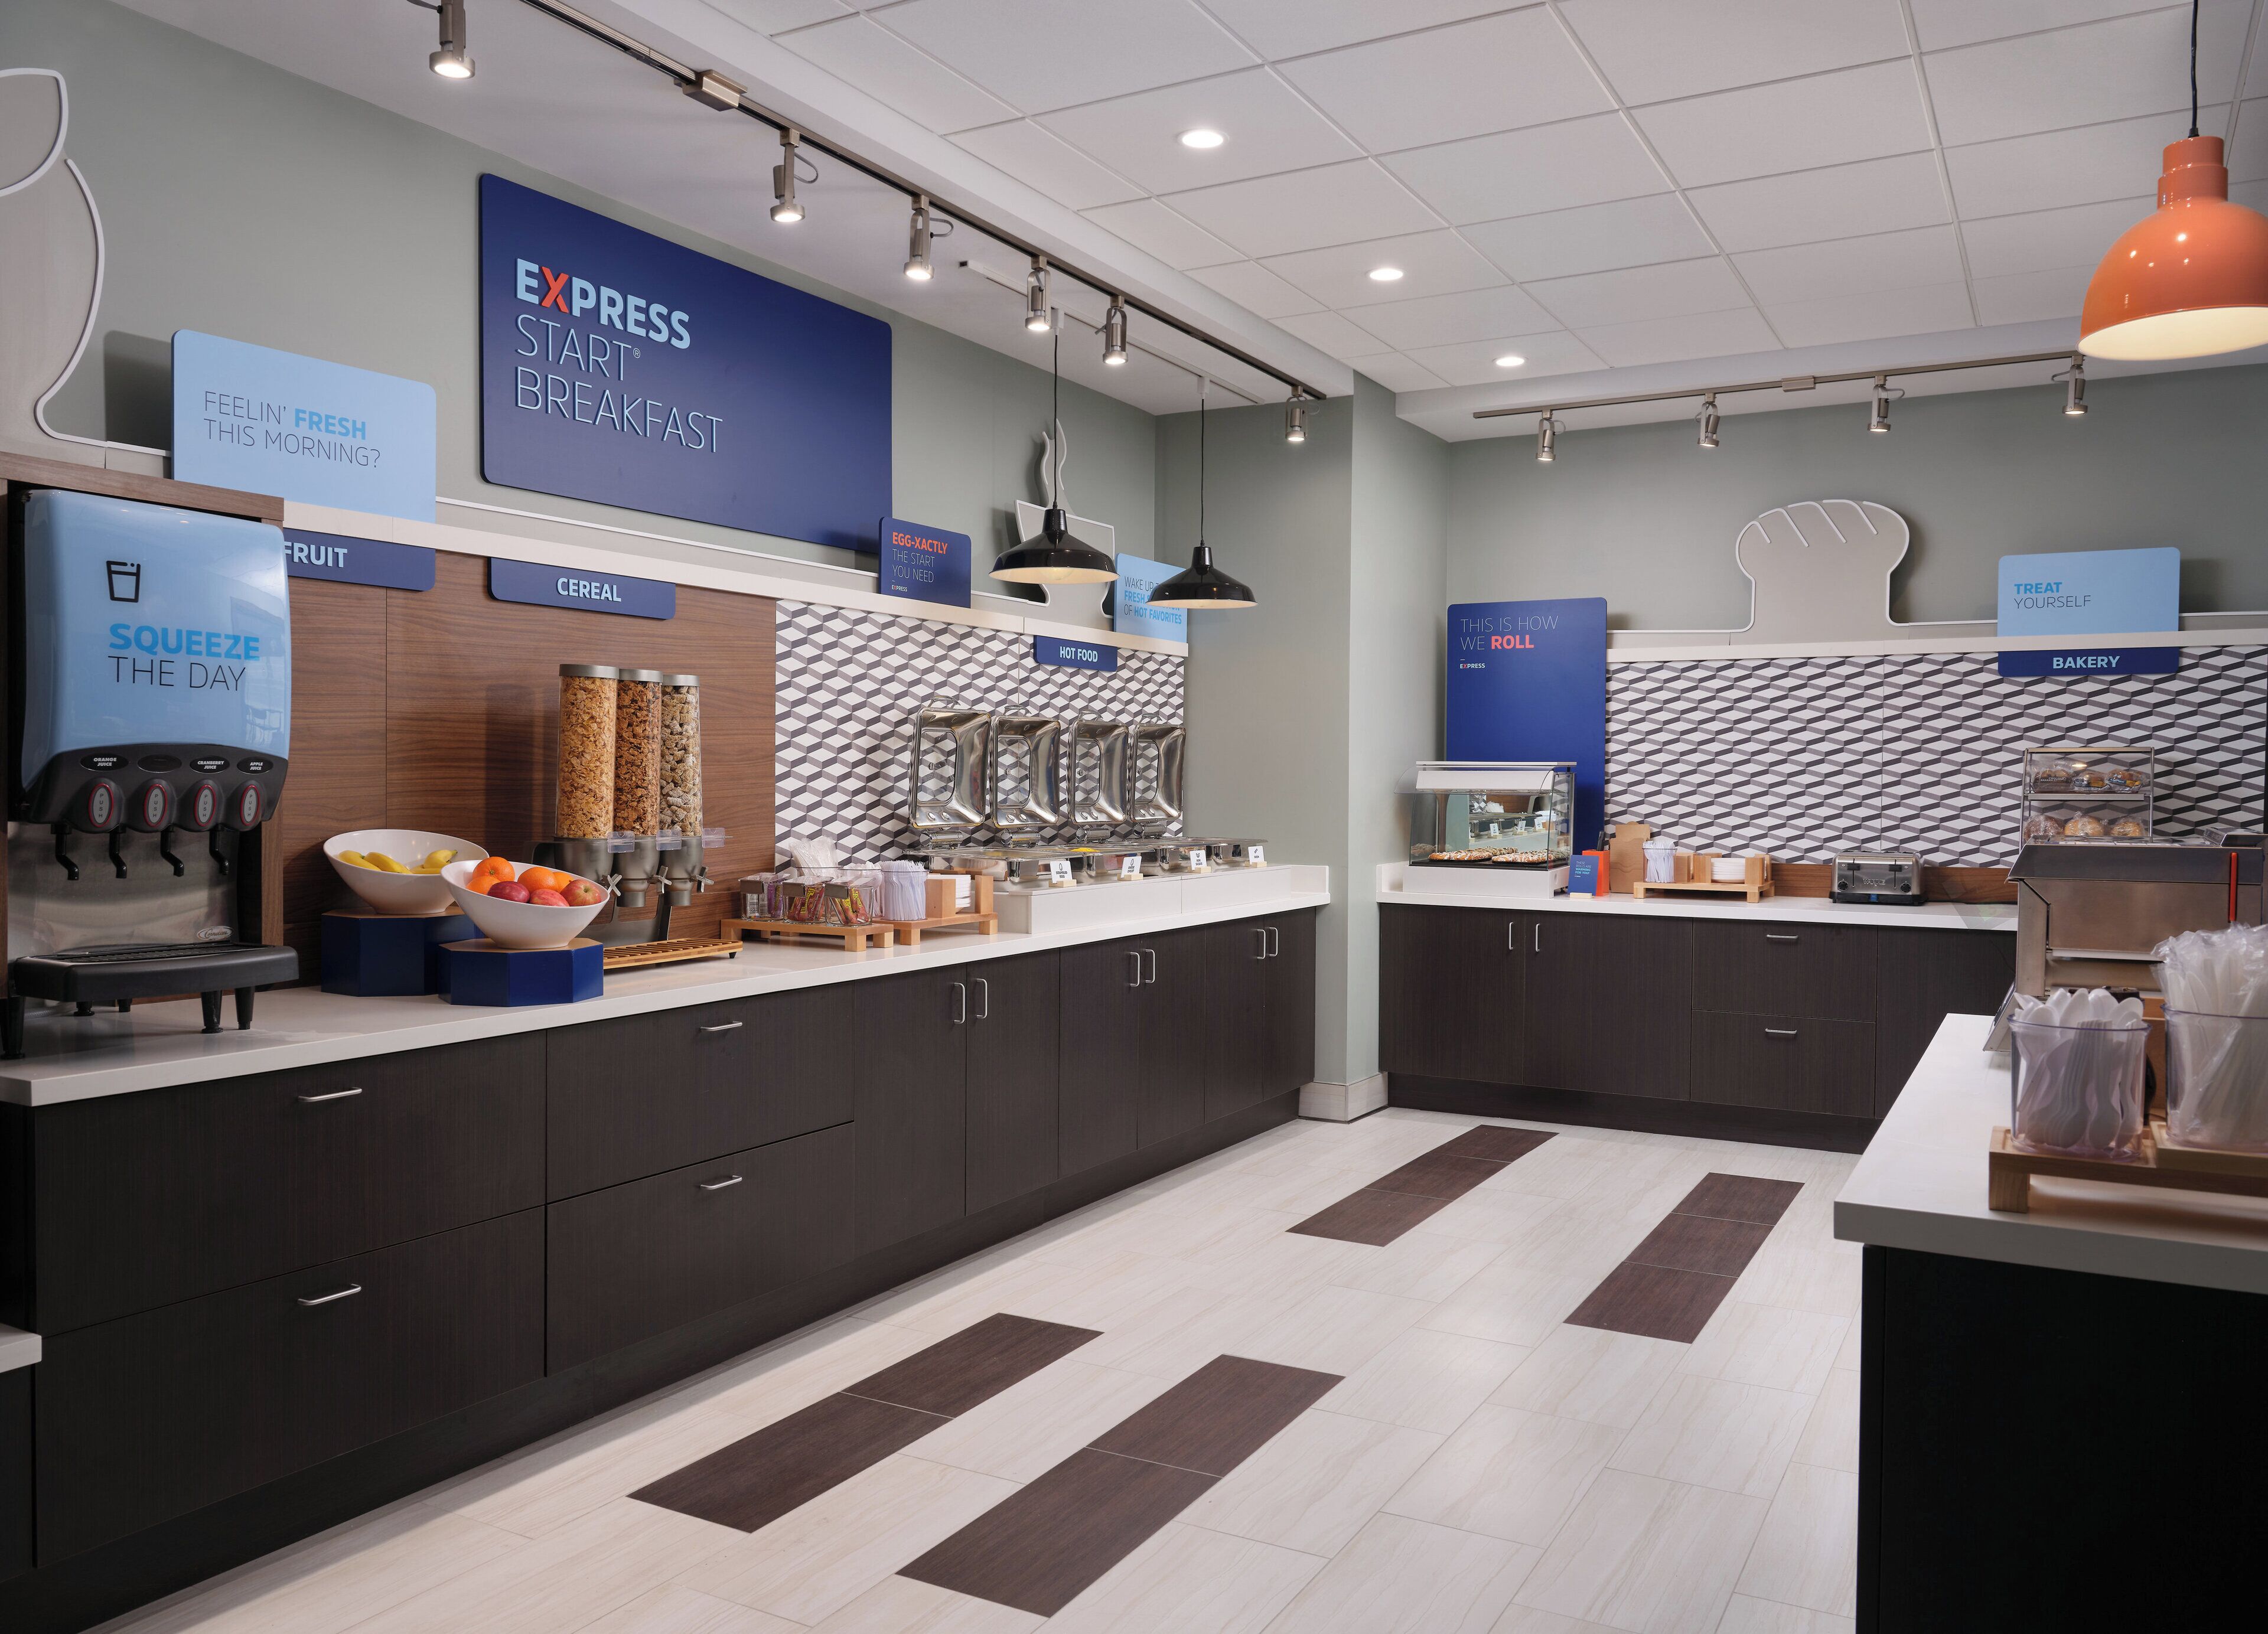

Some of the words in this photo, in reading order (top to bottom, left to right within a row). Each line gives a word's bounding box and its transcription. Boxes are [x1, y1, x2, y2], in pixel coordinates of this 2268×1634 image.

[516, 258, 691, 349] EXPRESS
[516, 366, 723, 453] BREAKFAST
[295, 408, 366, 440] FRESH
[204, 418, 255, 446] THIS
[266, 429, 380, 468] MORNING?
[892, 531, 948, 555] EGG-XACTLY
[892, 549, 908, 563] THE
[911, 552, 935, 568] START
[892, 564, 910, 579] YOU
[913, 569, 934, 583] NEED
[556, 578, 622, 602] CEREAL
[1125, 576, 1143, 591] WAKE
[1145, 580, 1154, 592] UP
[2014, 582, 2062, 595] TREAT
[1125, 589, 1146, 604] FRESH
[2013, 595, 2091, 609] YOURSELF
[1124, 604, 1132, 615] OF
[1134, 606, 1148, 618] HOT
[1149, 609, 1182, 624] FAVORITES
[1461, 618, 1493, 632] THIS
[1500, 617, 1511, 631] IS
[1518, 615, 1559, 631] HOW
[109, 623, 260, 661] SQUEEZE
[1461, 636, 1485, 650] WE
[1491, 634, 1534, 650] ROLL
[1060, 646, 1076, 660] HOT
[1077, 648, 1098, 663] FOOD
[2052, 655, 2120, 669] BAKERY
[107, 655, 175, 687] THE
[190, 663, 246, 691] DAY
